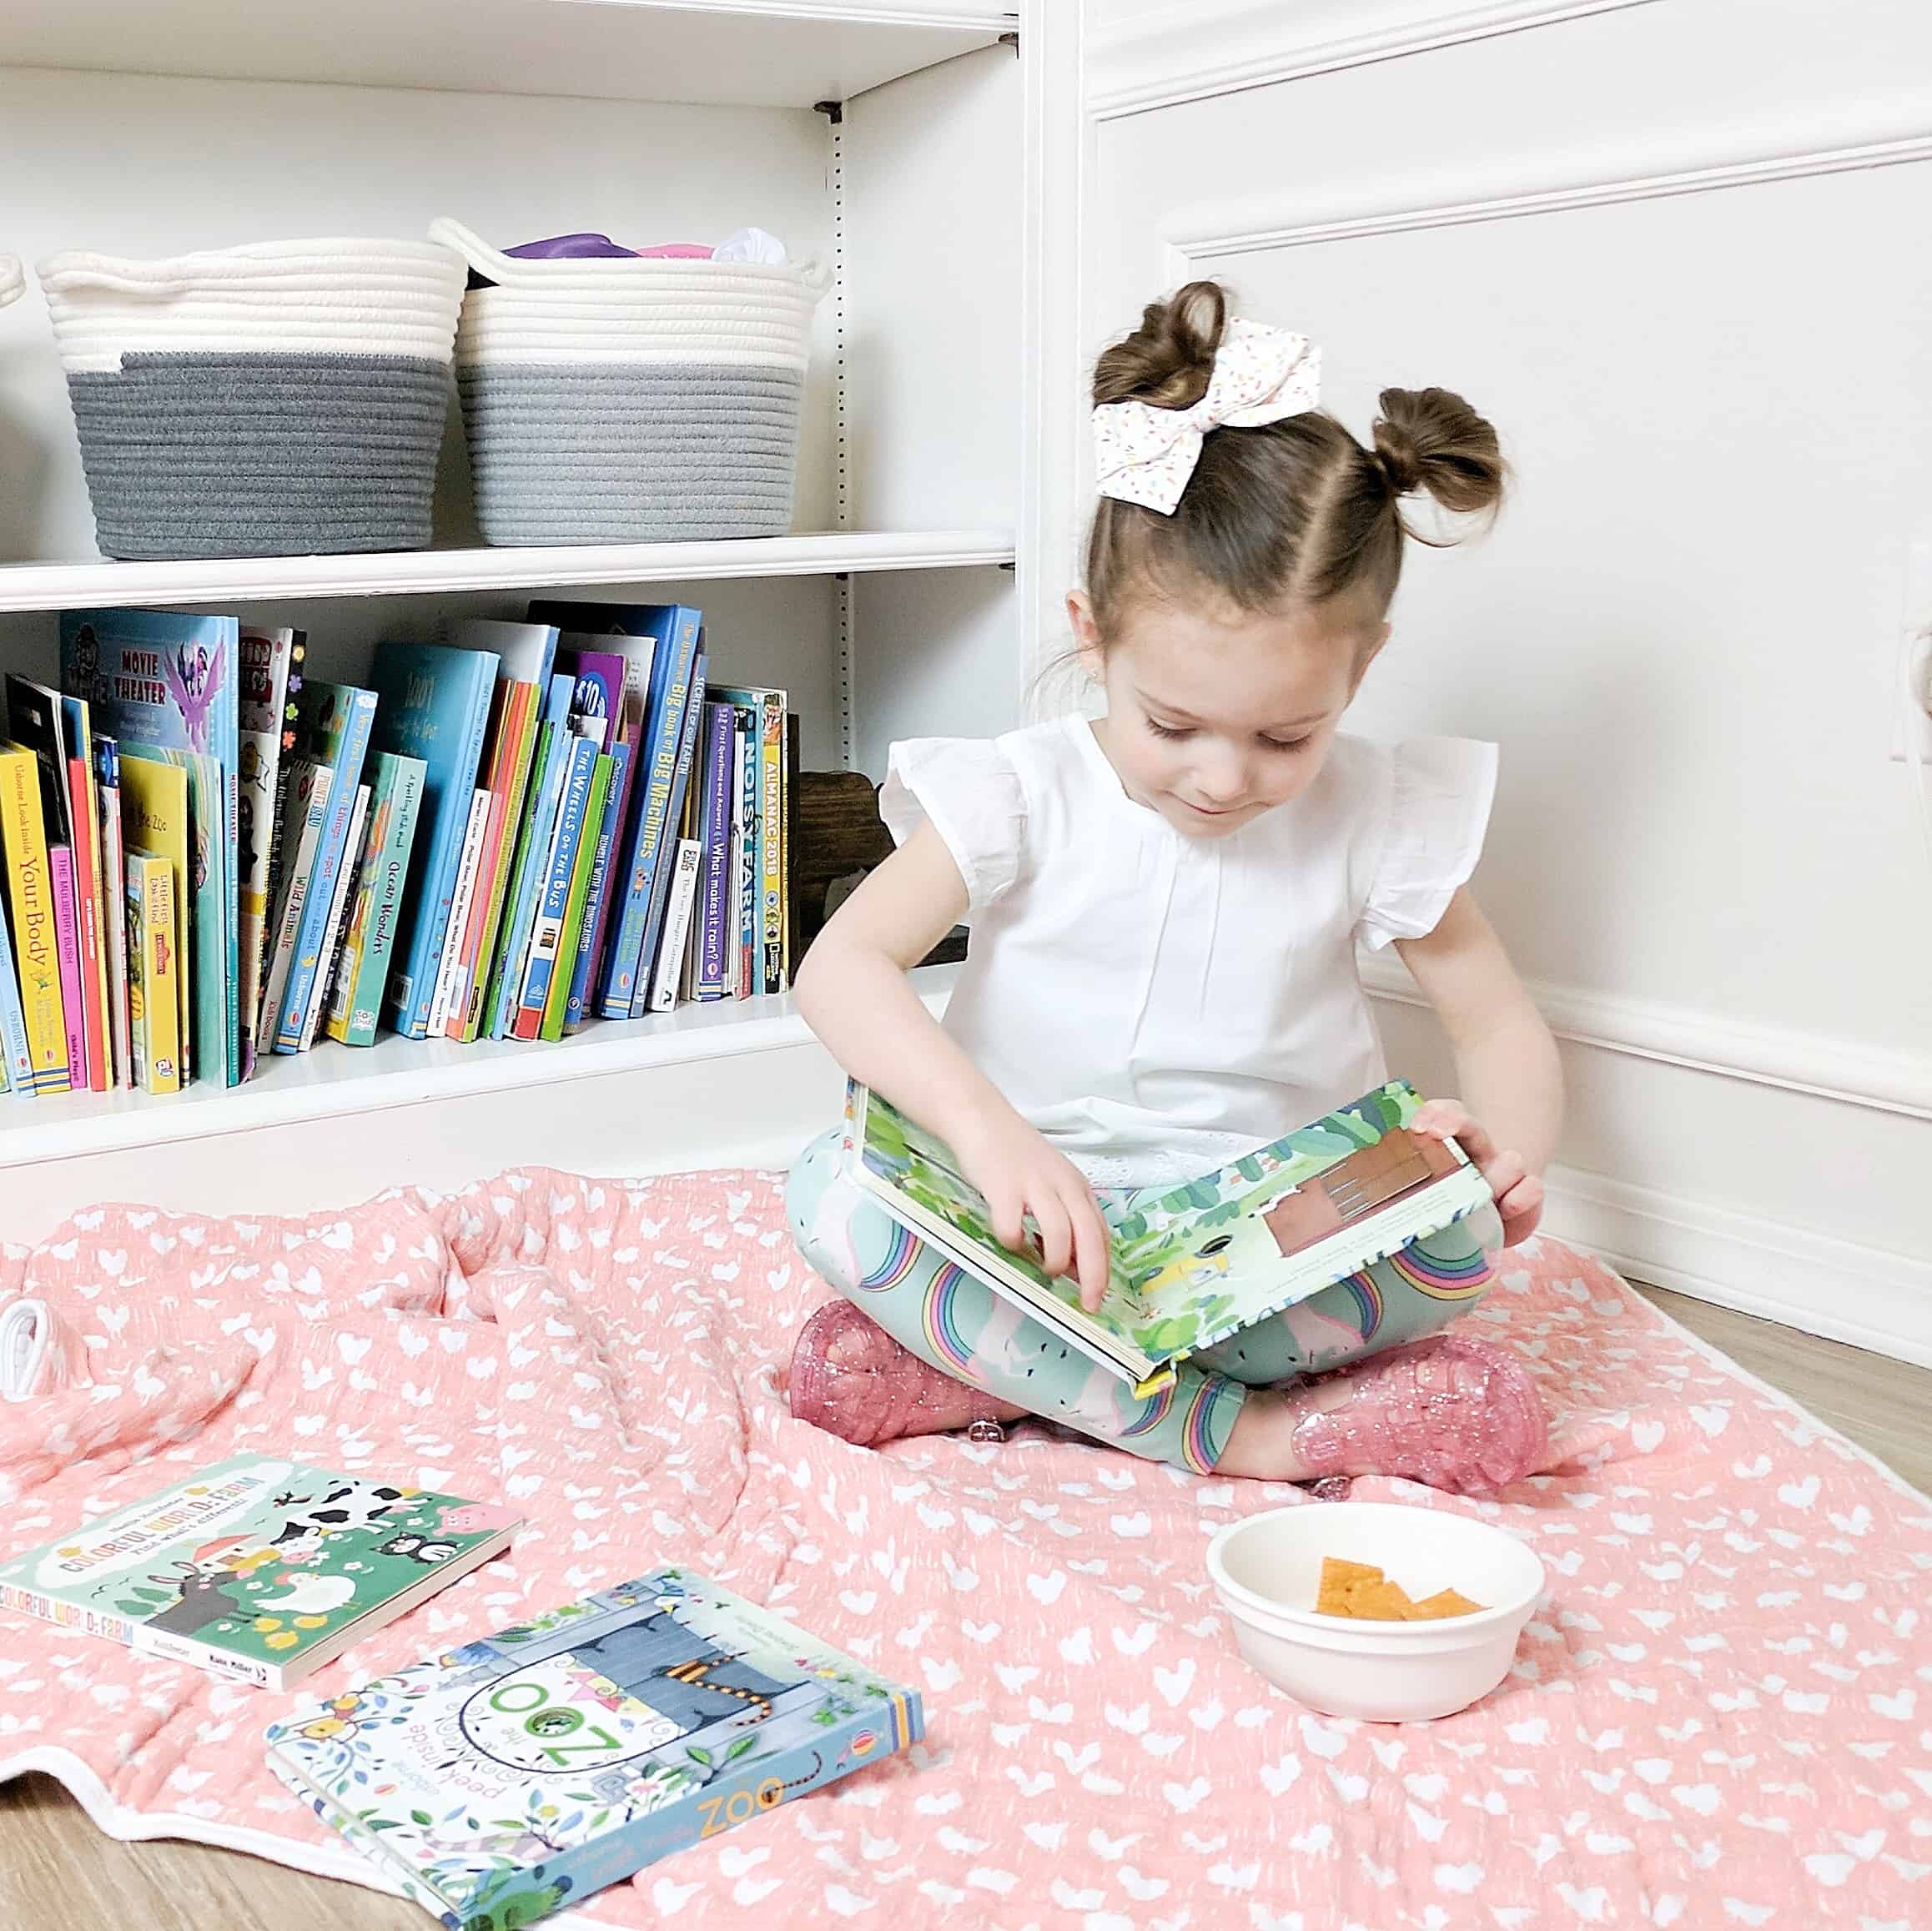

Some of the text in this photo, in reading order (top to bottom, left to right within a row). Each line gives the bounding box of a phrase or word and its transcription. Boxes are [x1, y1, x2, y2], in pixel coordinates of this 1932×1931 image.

[123, 651, 158, 676] MOVIE
[113, 676, 166, 706] THEATER
[665, 683, 686, 707] Big
[689, 675, 706, 715] SECRETS
[662, 708, 679, 738] book
[718, 726, 727, 744] First
[662, 739, 672, 751] of
[677, 744, 693, 775] EARTH
[653, 751, 675, 779] Big
[716, 746, 726, 781] Questions
[13, 764, 27, 800] Usborne
[17, 802, 29, 824] Look
[330, 805, 347, 838] things
[547, 748, 591, 908] THE WHEELS ON THE BUS
[636, 781, 671, 860] Machines
[766, 762, 777, 875] ALMANAC 2018
[321, 855, 335, 878] spot
[465, 845, 475, 862] Polar
[710, 843, 723, 876] What
[18, 857, 42, 907] Your
[317, 881, 329, 901] out
[457, 885, 467, 903] Polar
[579, 832, 610, 953] RUMBLE WITH THE DINOSAURS!
[708, 880, 720, 914] makes
[743, 851, 753, 932] FARM
[58, 859, 73, 964] THE MULBERRY BUSH
[280, 874, 307, 949] Wild Animals
[371, 860, 400, 956] Ocean Wonders
[708, 916, 718, 924] it
[23, 911, 49, 967] Body
[306, 918, 320, 949] about
[447, 943, 455, 954] Do
[450, 924, 460, 943] What
[707, 928, 719, 959] rain?
[445, 955, 453, 968] You
[292, 973, 308, 1010] Usborne
[440, 969, 450, 991] Hear?
[8, 1010, 26, 1054] USBORNE
[59, 1531, 156, 1572] COLORFUL
[490, 1683, 623, 1767] ZOO
[401, 1724, 509, 1799] peek inside
[697, 1776, 784, 1840] ZOO
